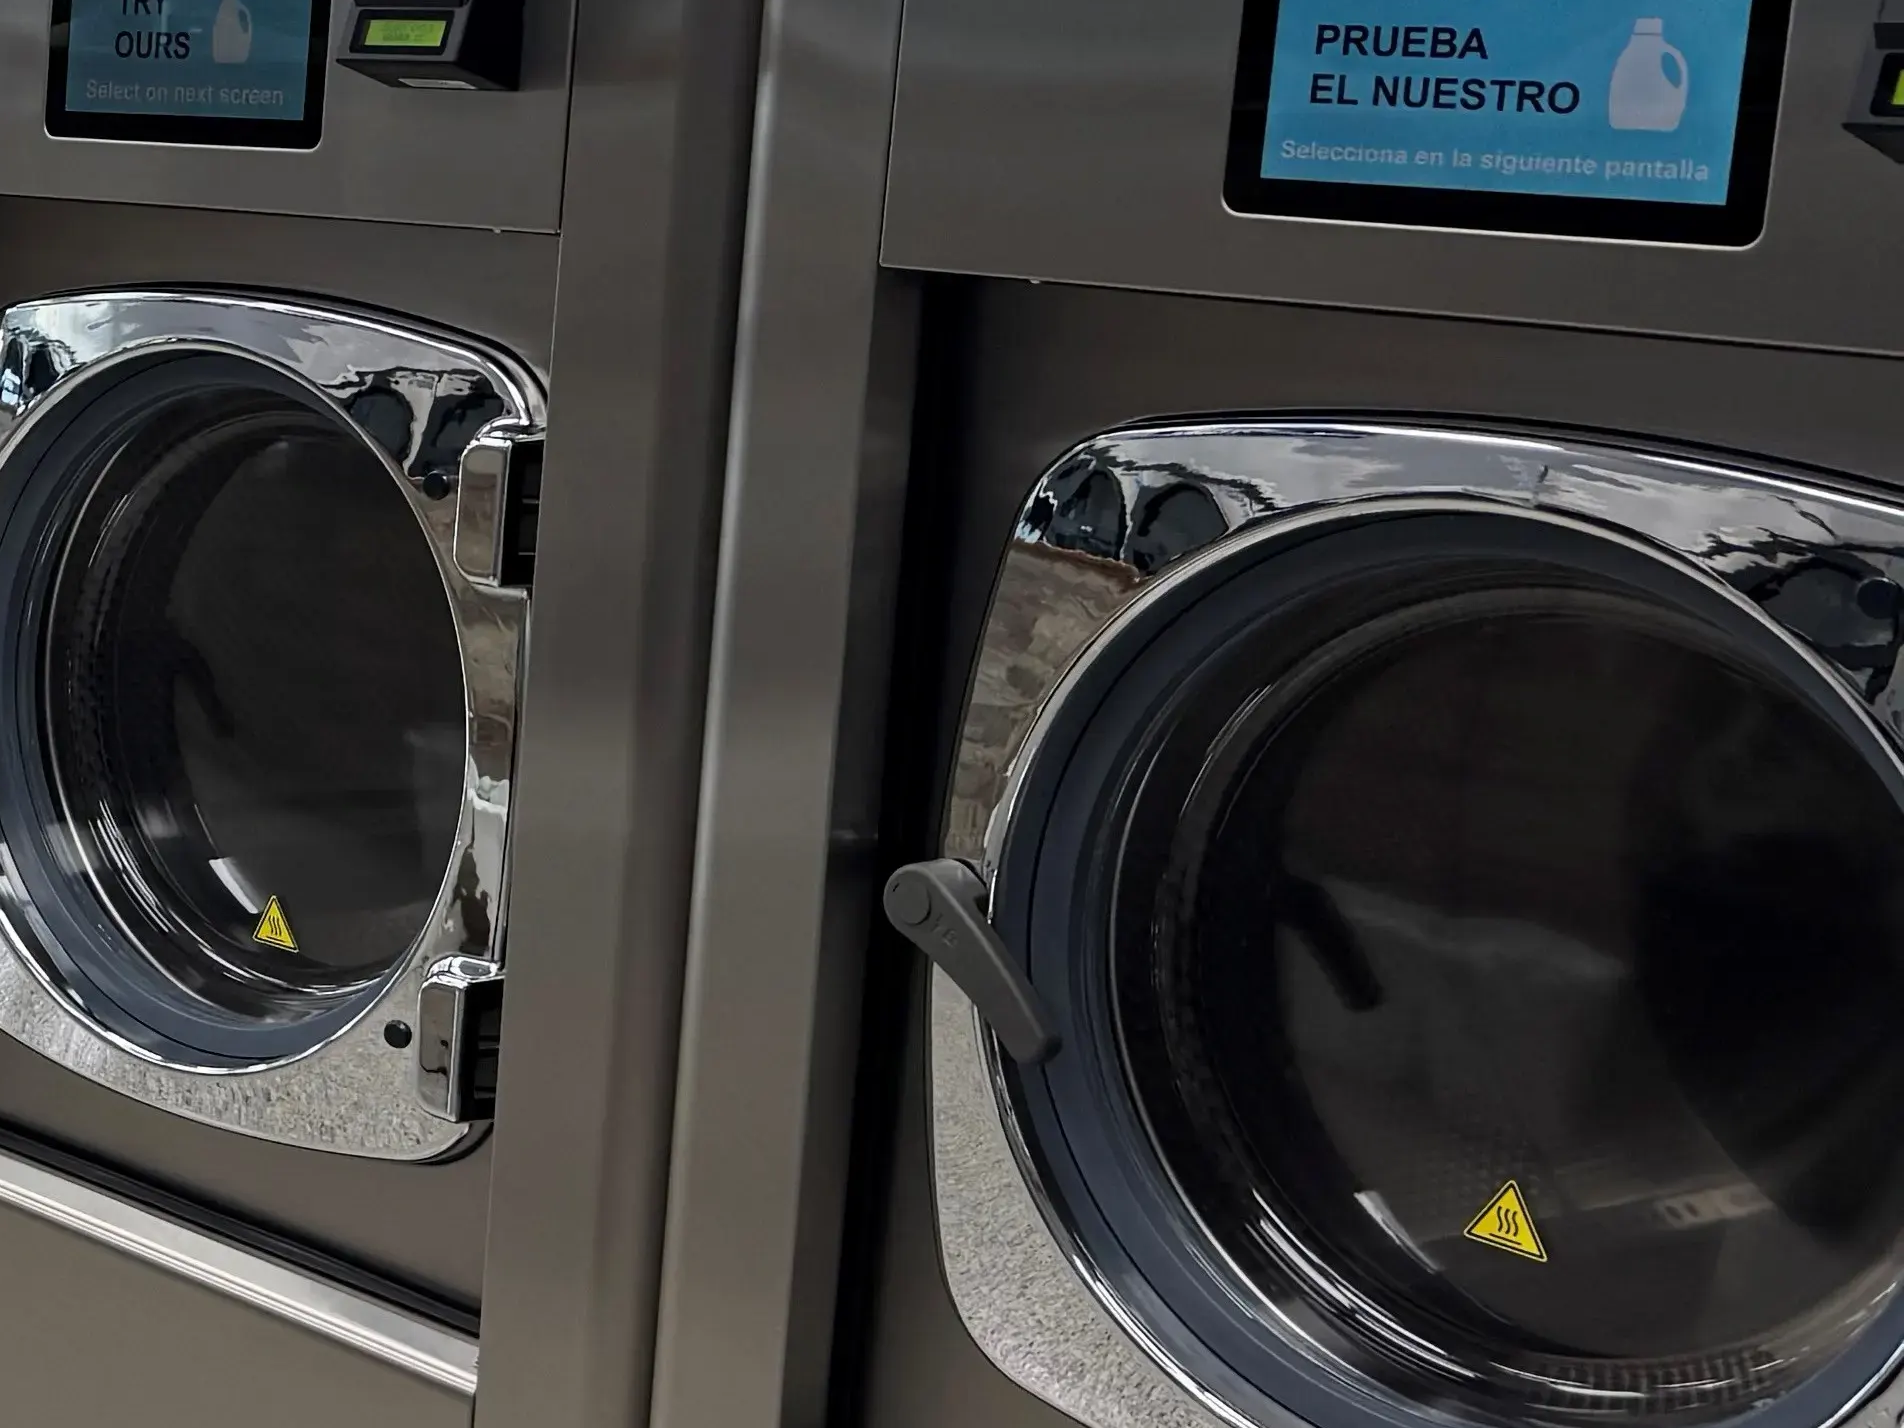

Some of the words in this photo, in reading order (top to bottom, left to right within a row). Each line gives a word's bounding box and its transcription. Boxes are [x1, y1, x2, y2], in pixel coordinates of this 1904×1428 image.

[114, 30, 192, 60] OURS
[1314, 24, 1490, 60] PRUEBA
[86, 79, 141, 102] Select
[145, 86, 168, 103] on
[174, 84, 214, 104] next
[219, 86, 284, 106] screen
[1309, 73, 1359, 106] EL
[1372, 75, 1581, 115] NUESTRO
[1281, 140, 1409, 166] Selecciona
[1414, 149, 1444, 168] en
[1452, 148, 1474, 168] la
[1479, 150, 1597, 176] siguiente
[1604, 157, 1710, 183] pantalla
